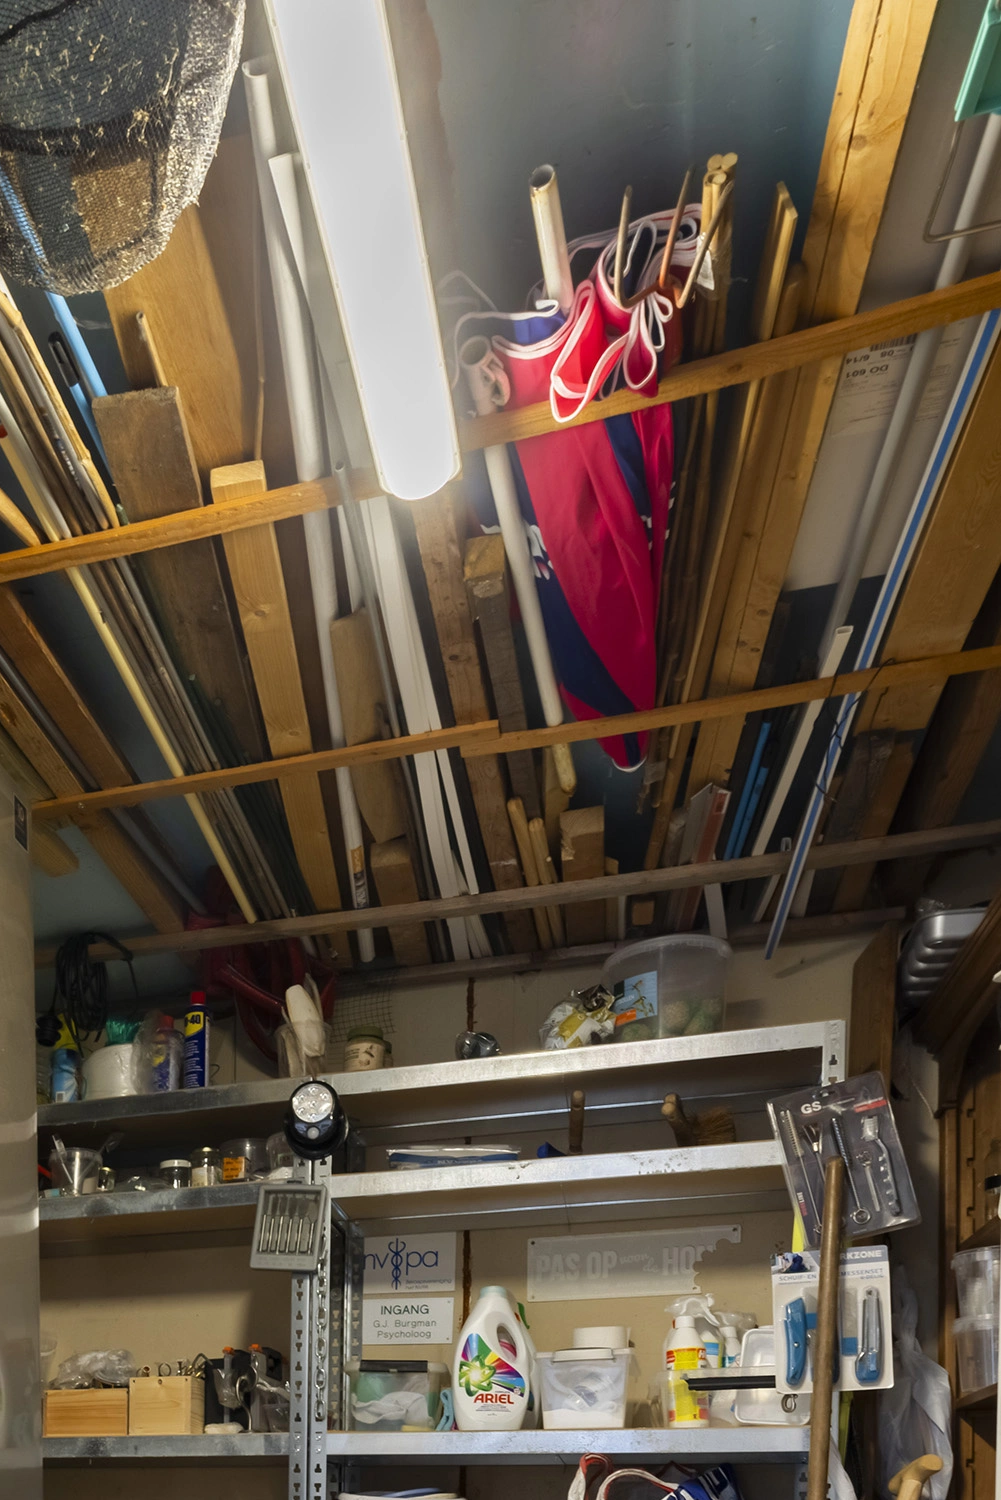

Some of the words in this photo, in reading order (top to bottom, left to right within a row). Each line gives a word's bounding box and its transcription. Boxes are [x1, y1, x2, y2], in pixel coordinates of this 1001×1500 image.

[840, 1249, 883, 1261] RKZONE
[535, 1251, 580, 1281] PAS
[586, 1250, 618, 1280] OP
[661, 1245, 716, 1276] HO
[380, 1304, 430, 1315] INGANG
[394, 1318, 437, 1329] Burgman
[377, 1330, 432, 1340] Psycholoog
[473, 1393, 515, 1405] ARIEL
